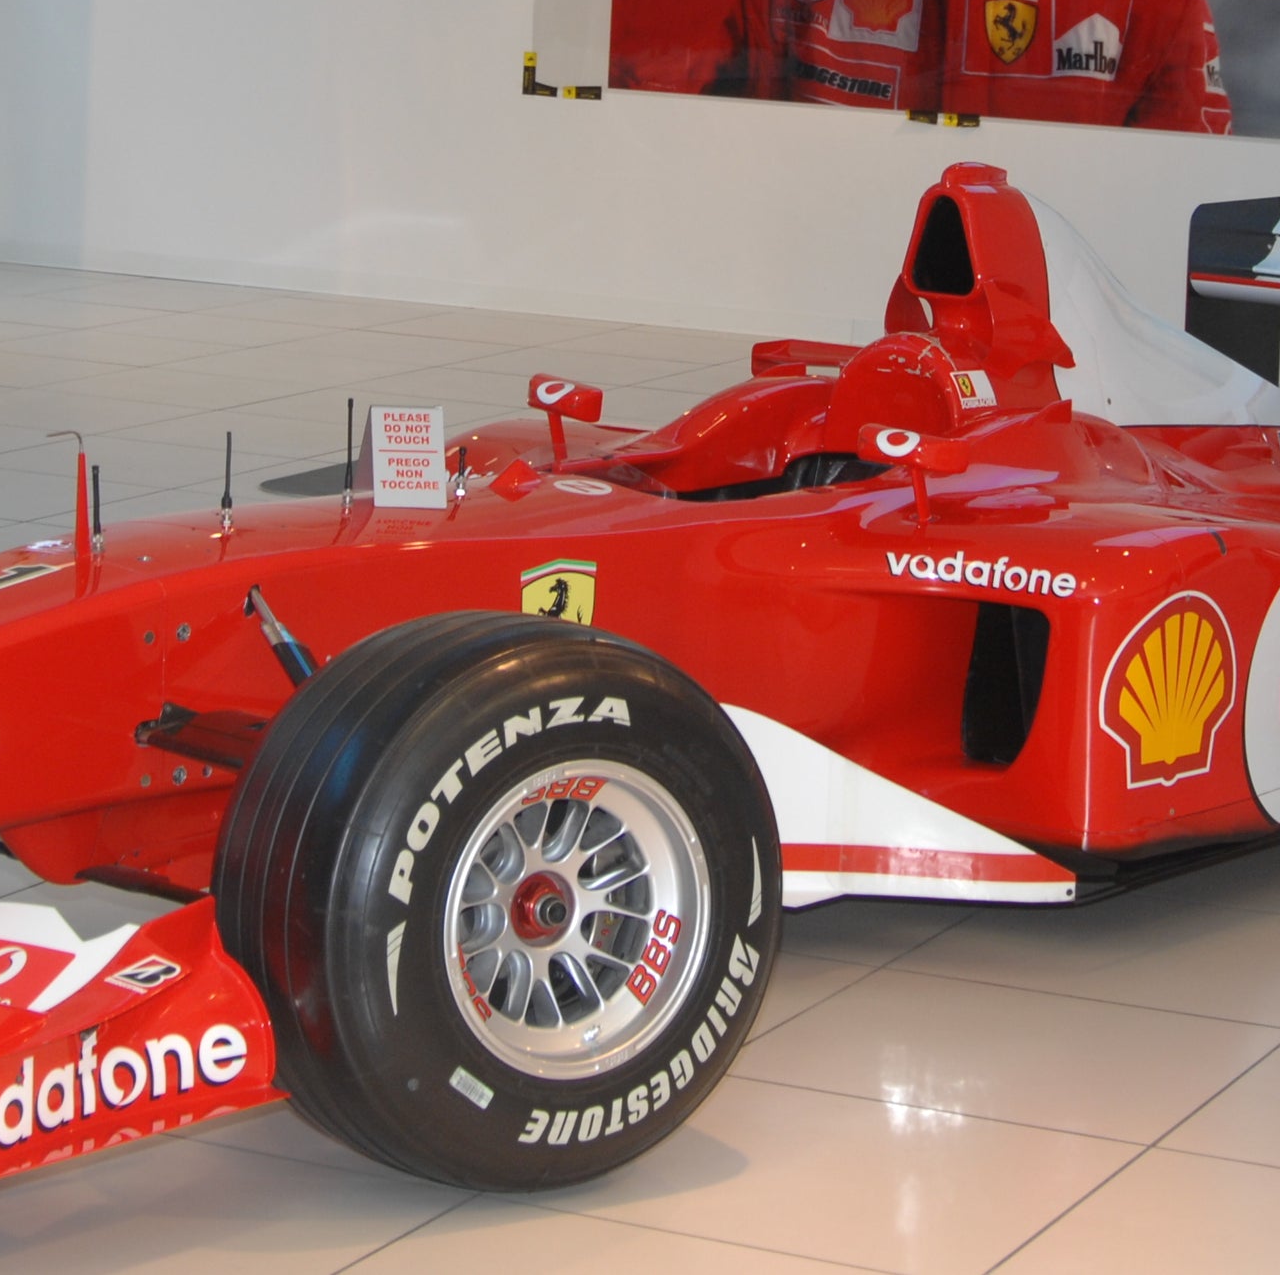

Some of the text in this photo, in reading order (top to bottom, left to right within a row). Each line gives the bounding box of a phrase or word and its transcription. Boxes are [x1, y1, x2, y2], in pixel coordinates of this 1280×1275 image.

[383, 412, 431, 422] PLEASE
[384, 424, 431, 434] DO NOT
[386, 435, 430, 445] TOUCH
[388, 457, 430, 468] PREGO
[396, 469, 423, 478] NON
[380, 480, 439, 490] TOCCARE
[885, 550, 1077, 598] vodafone
[388, 696, 632, 905] POTENZA
[624, 908, 682, 1007] BBS
[517, 933, 761, 1147] BRIDGESTONE
